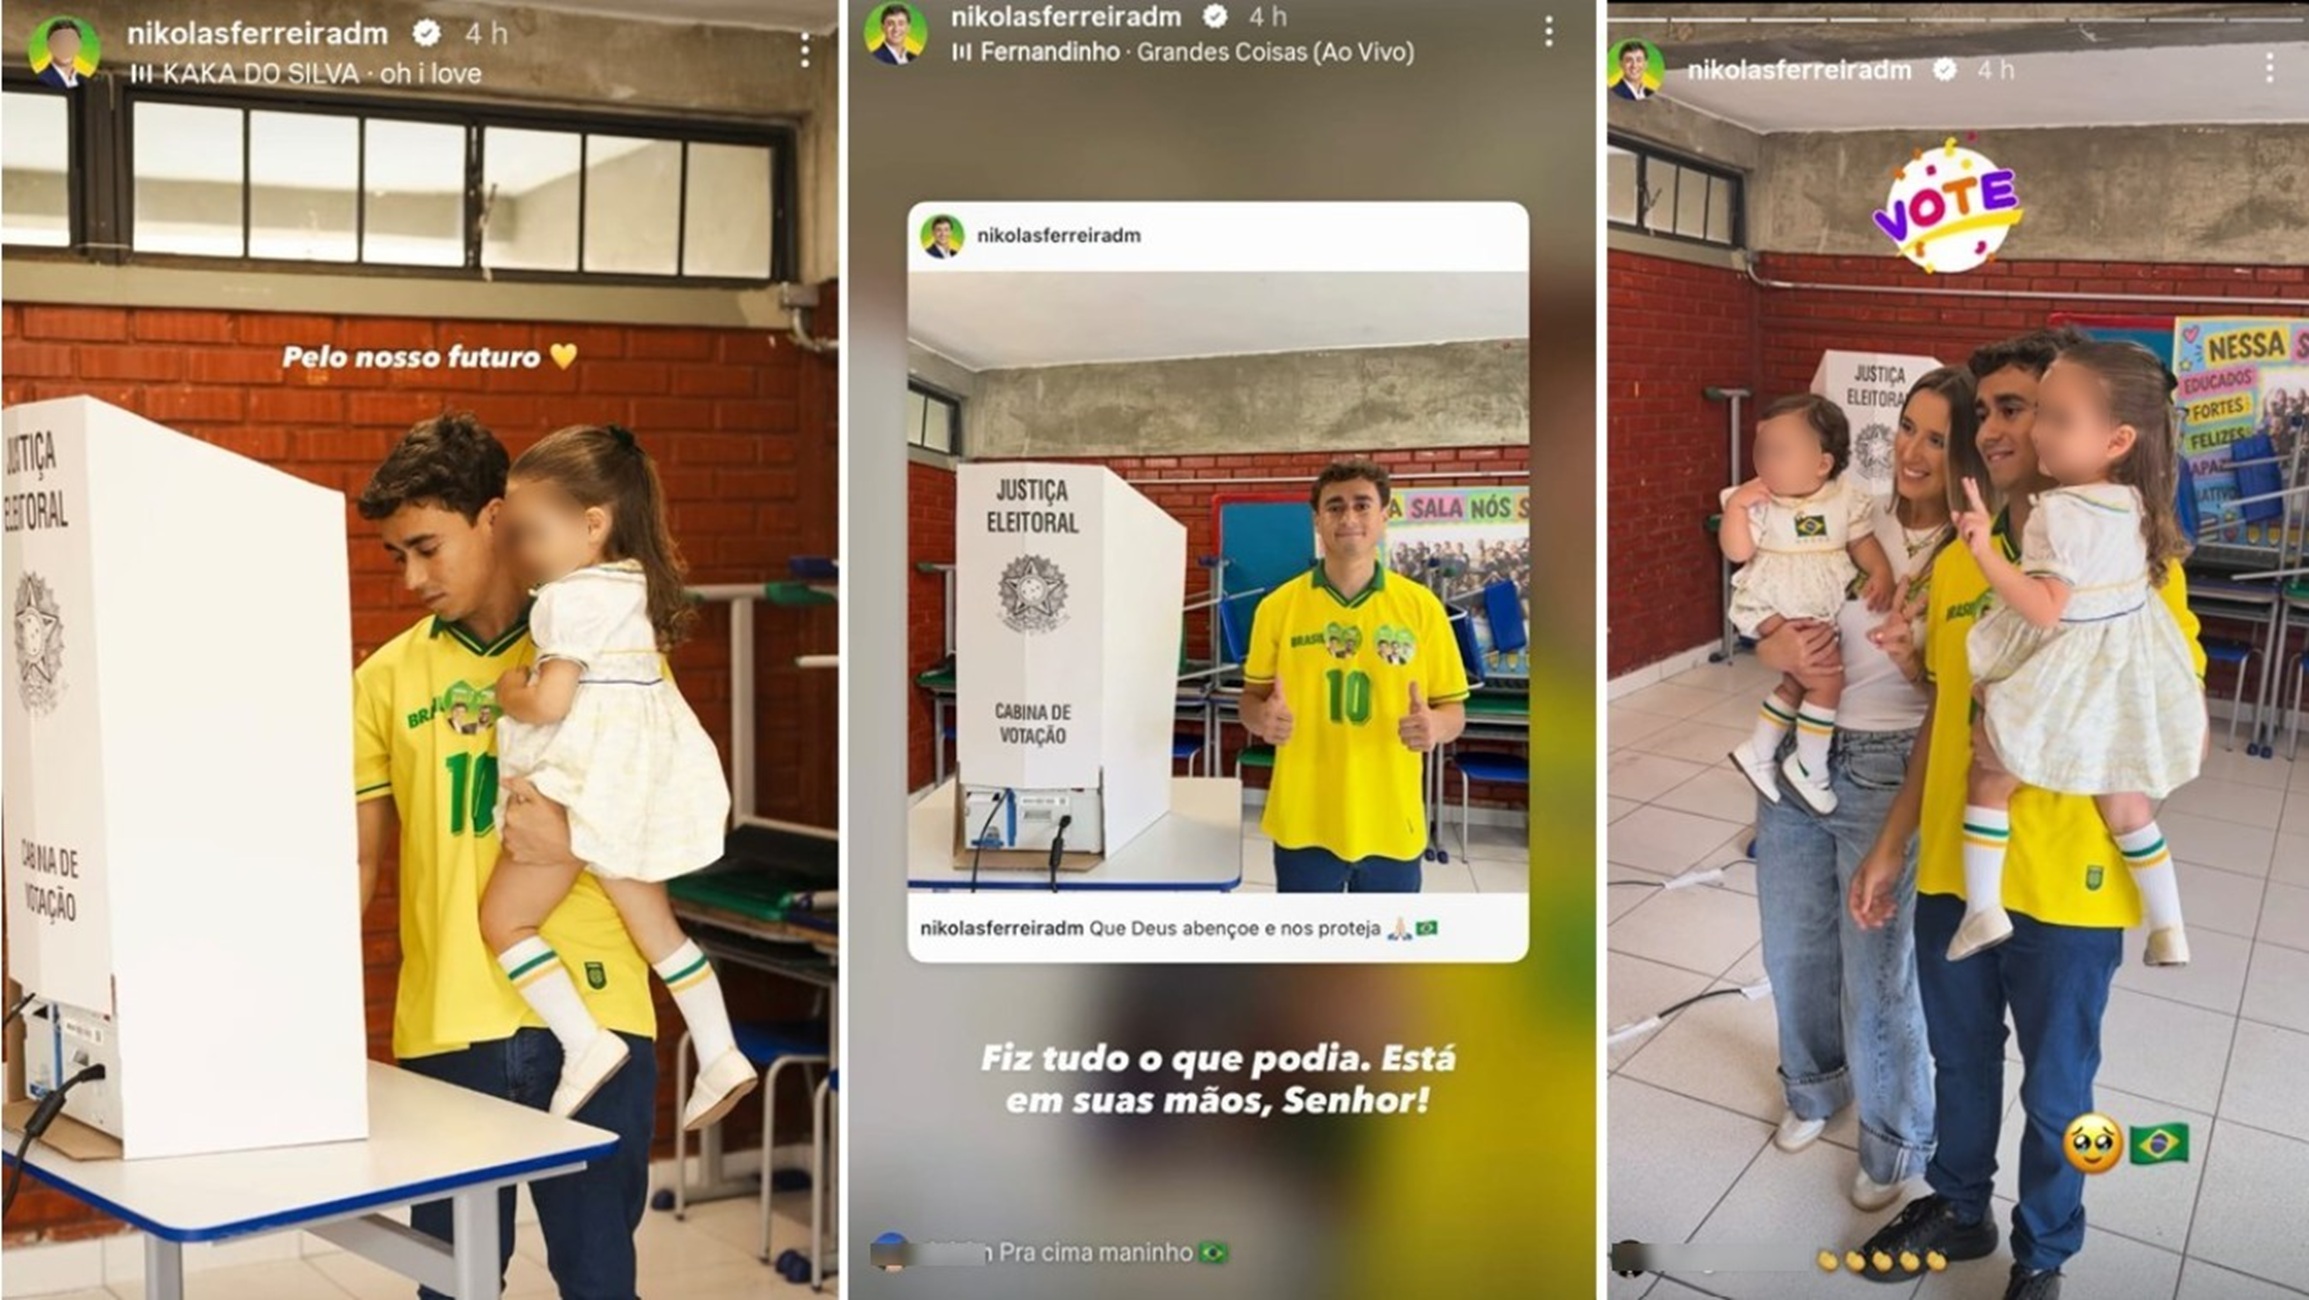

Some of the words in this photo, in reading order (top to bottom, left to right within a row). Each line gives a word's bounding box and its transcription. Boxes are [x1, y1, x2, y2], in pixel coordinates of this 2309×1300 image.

[2209, 330, 2286, 362] NESSA
[1854, 364, 1906, 387] JUSTIÇA
[2184, 369, 2254, 395] EDUCADOS
[1847, 388, 1907, 407] ELEITORA
[2193, 397, 2244, 421] FORTES
[2191, 427, 2246, 450] FELIZES
[996, 478, 1069, 507] JUSTIÇA
[1411, 497, 1463, 519] SALA
[1471, 493, 1511, 518] NÓS
[987, 511, 1080, 534] ELEITORAL
[1326, 669, 1371, 726] 10
[995, 702, 1048, 721] CABINA
[1051, 703, 1072, 721] DE
[1000, 724, 1067, 749] VOTAÇÃO
[60, 848, 79, 879] DE
